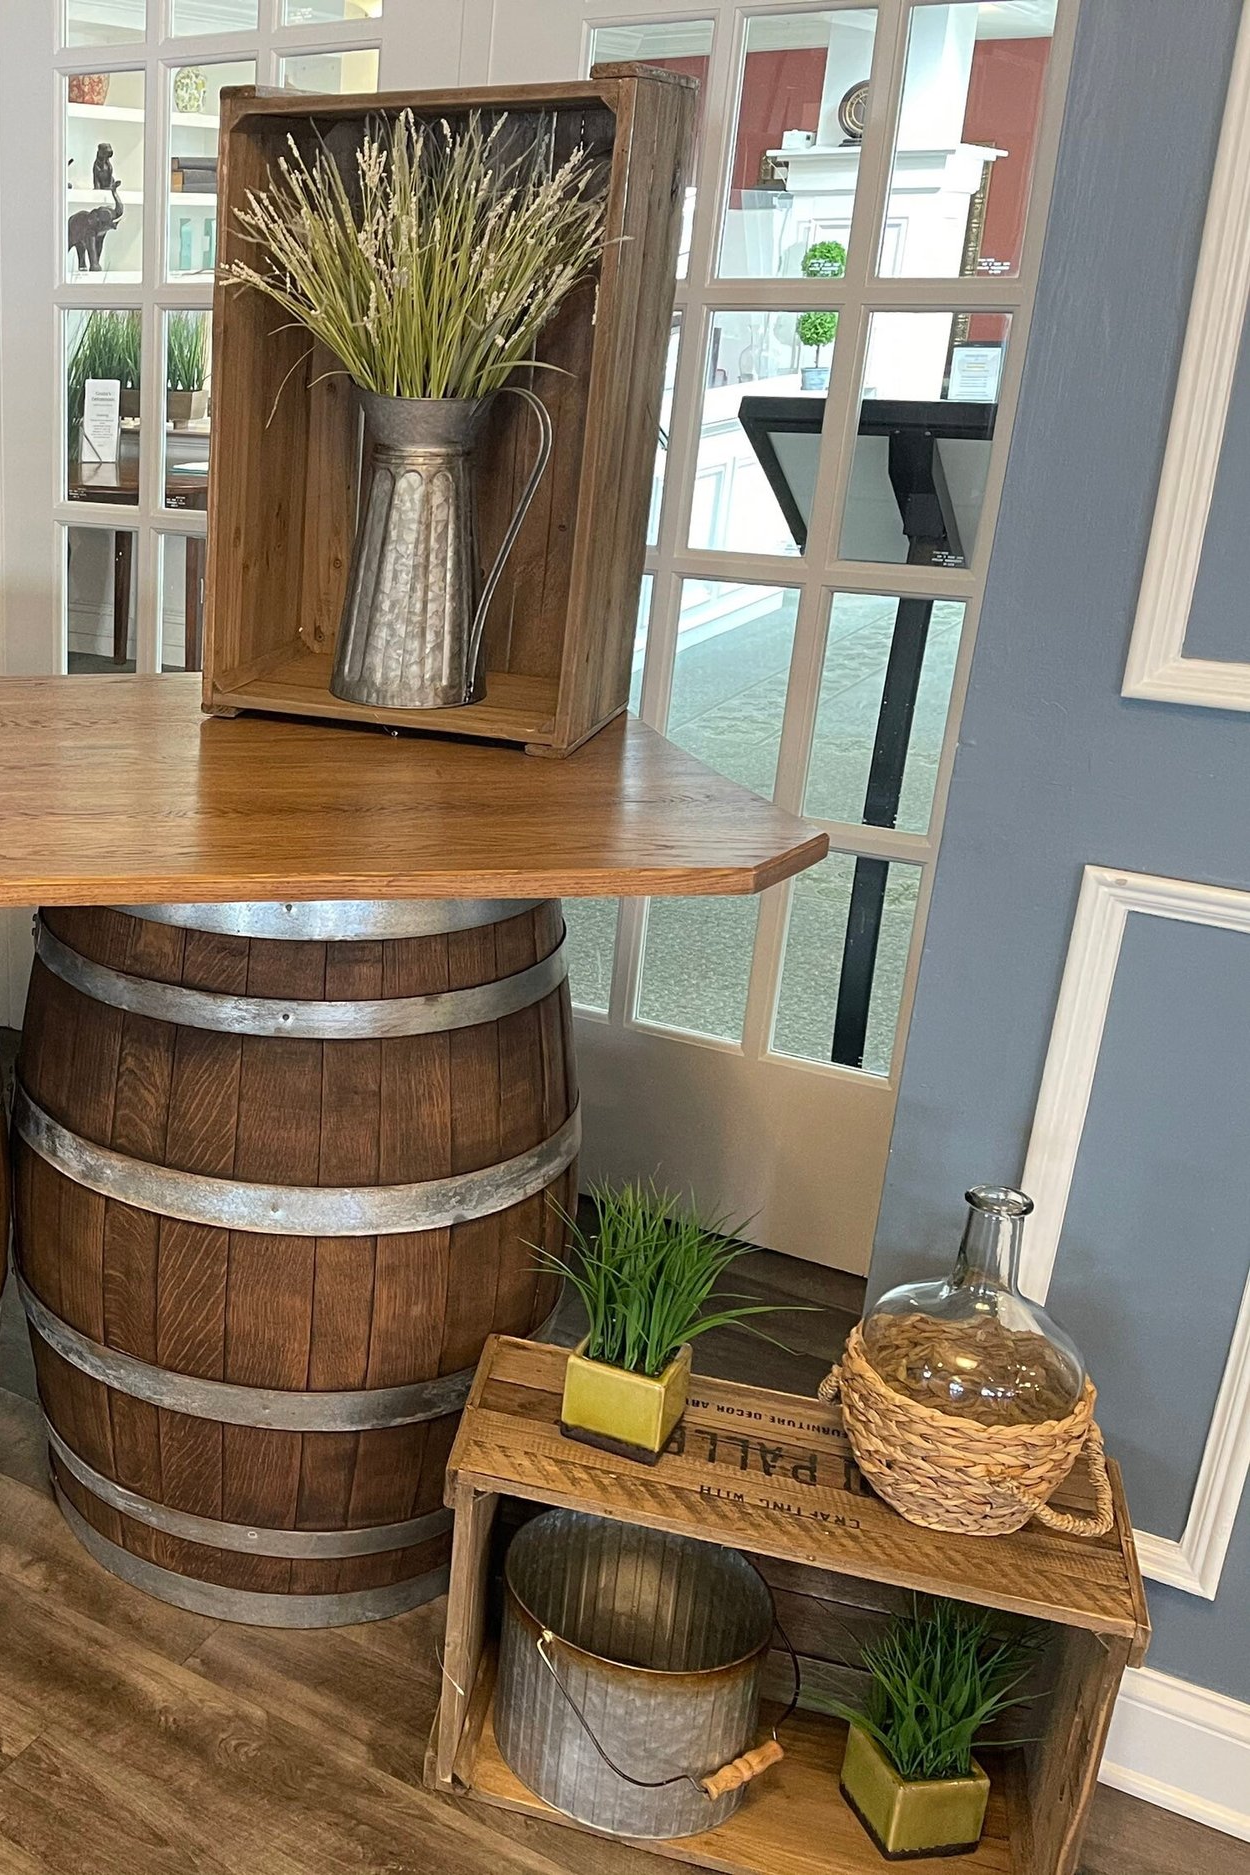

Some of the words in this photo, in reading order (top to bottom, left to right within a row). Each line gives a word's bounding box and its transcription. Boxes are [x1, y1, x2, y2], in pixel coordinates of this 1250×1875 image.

[716, 1404, 762, 1420] DECOR
[769, 1415, 848, 1439] FURNITURE
[699, 1484, 745, 1503] WITH
[759, 1498, 860, 1529] CRAFTING
